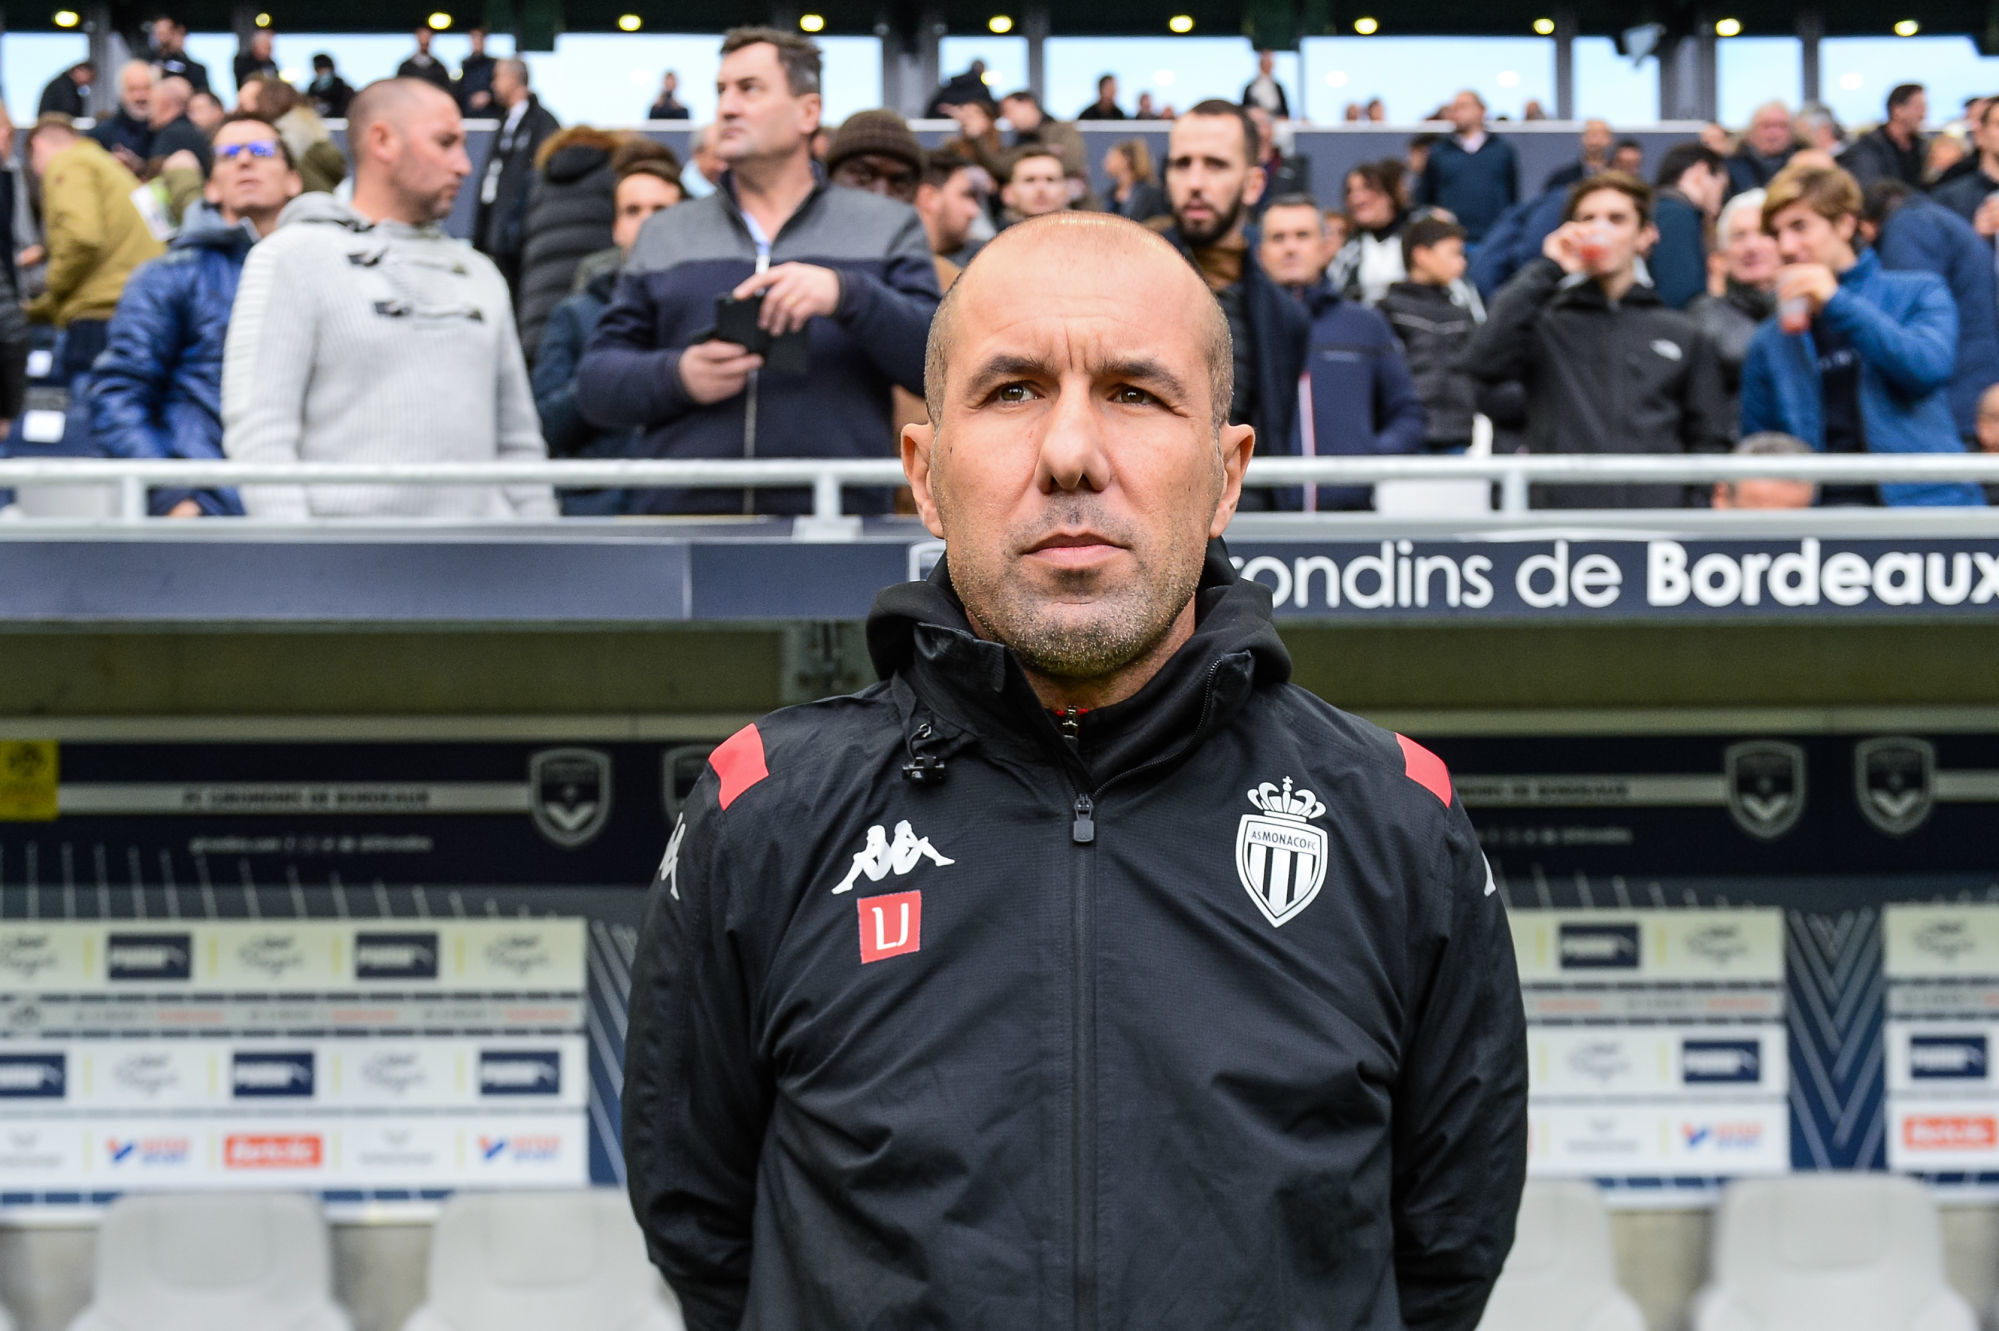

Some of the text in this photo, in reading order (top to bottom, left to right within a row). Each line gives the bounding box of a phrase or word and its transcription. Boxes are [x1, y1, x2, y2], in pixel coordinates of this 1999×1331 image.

[1230, 537, 1999, 609] ondins de Bordeaux
